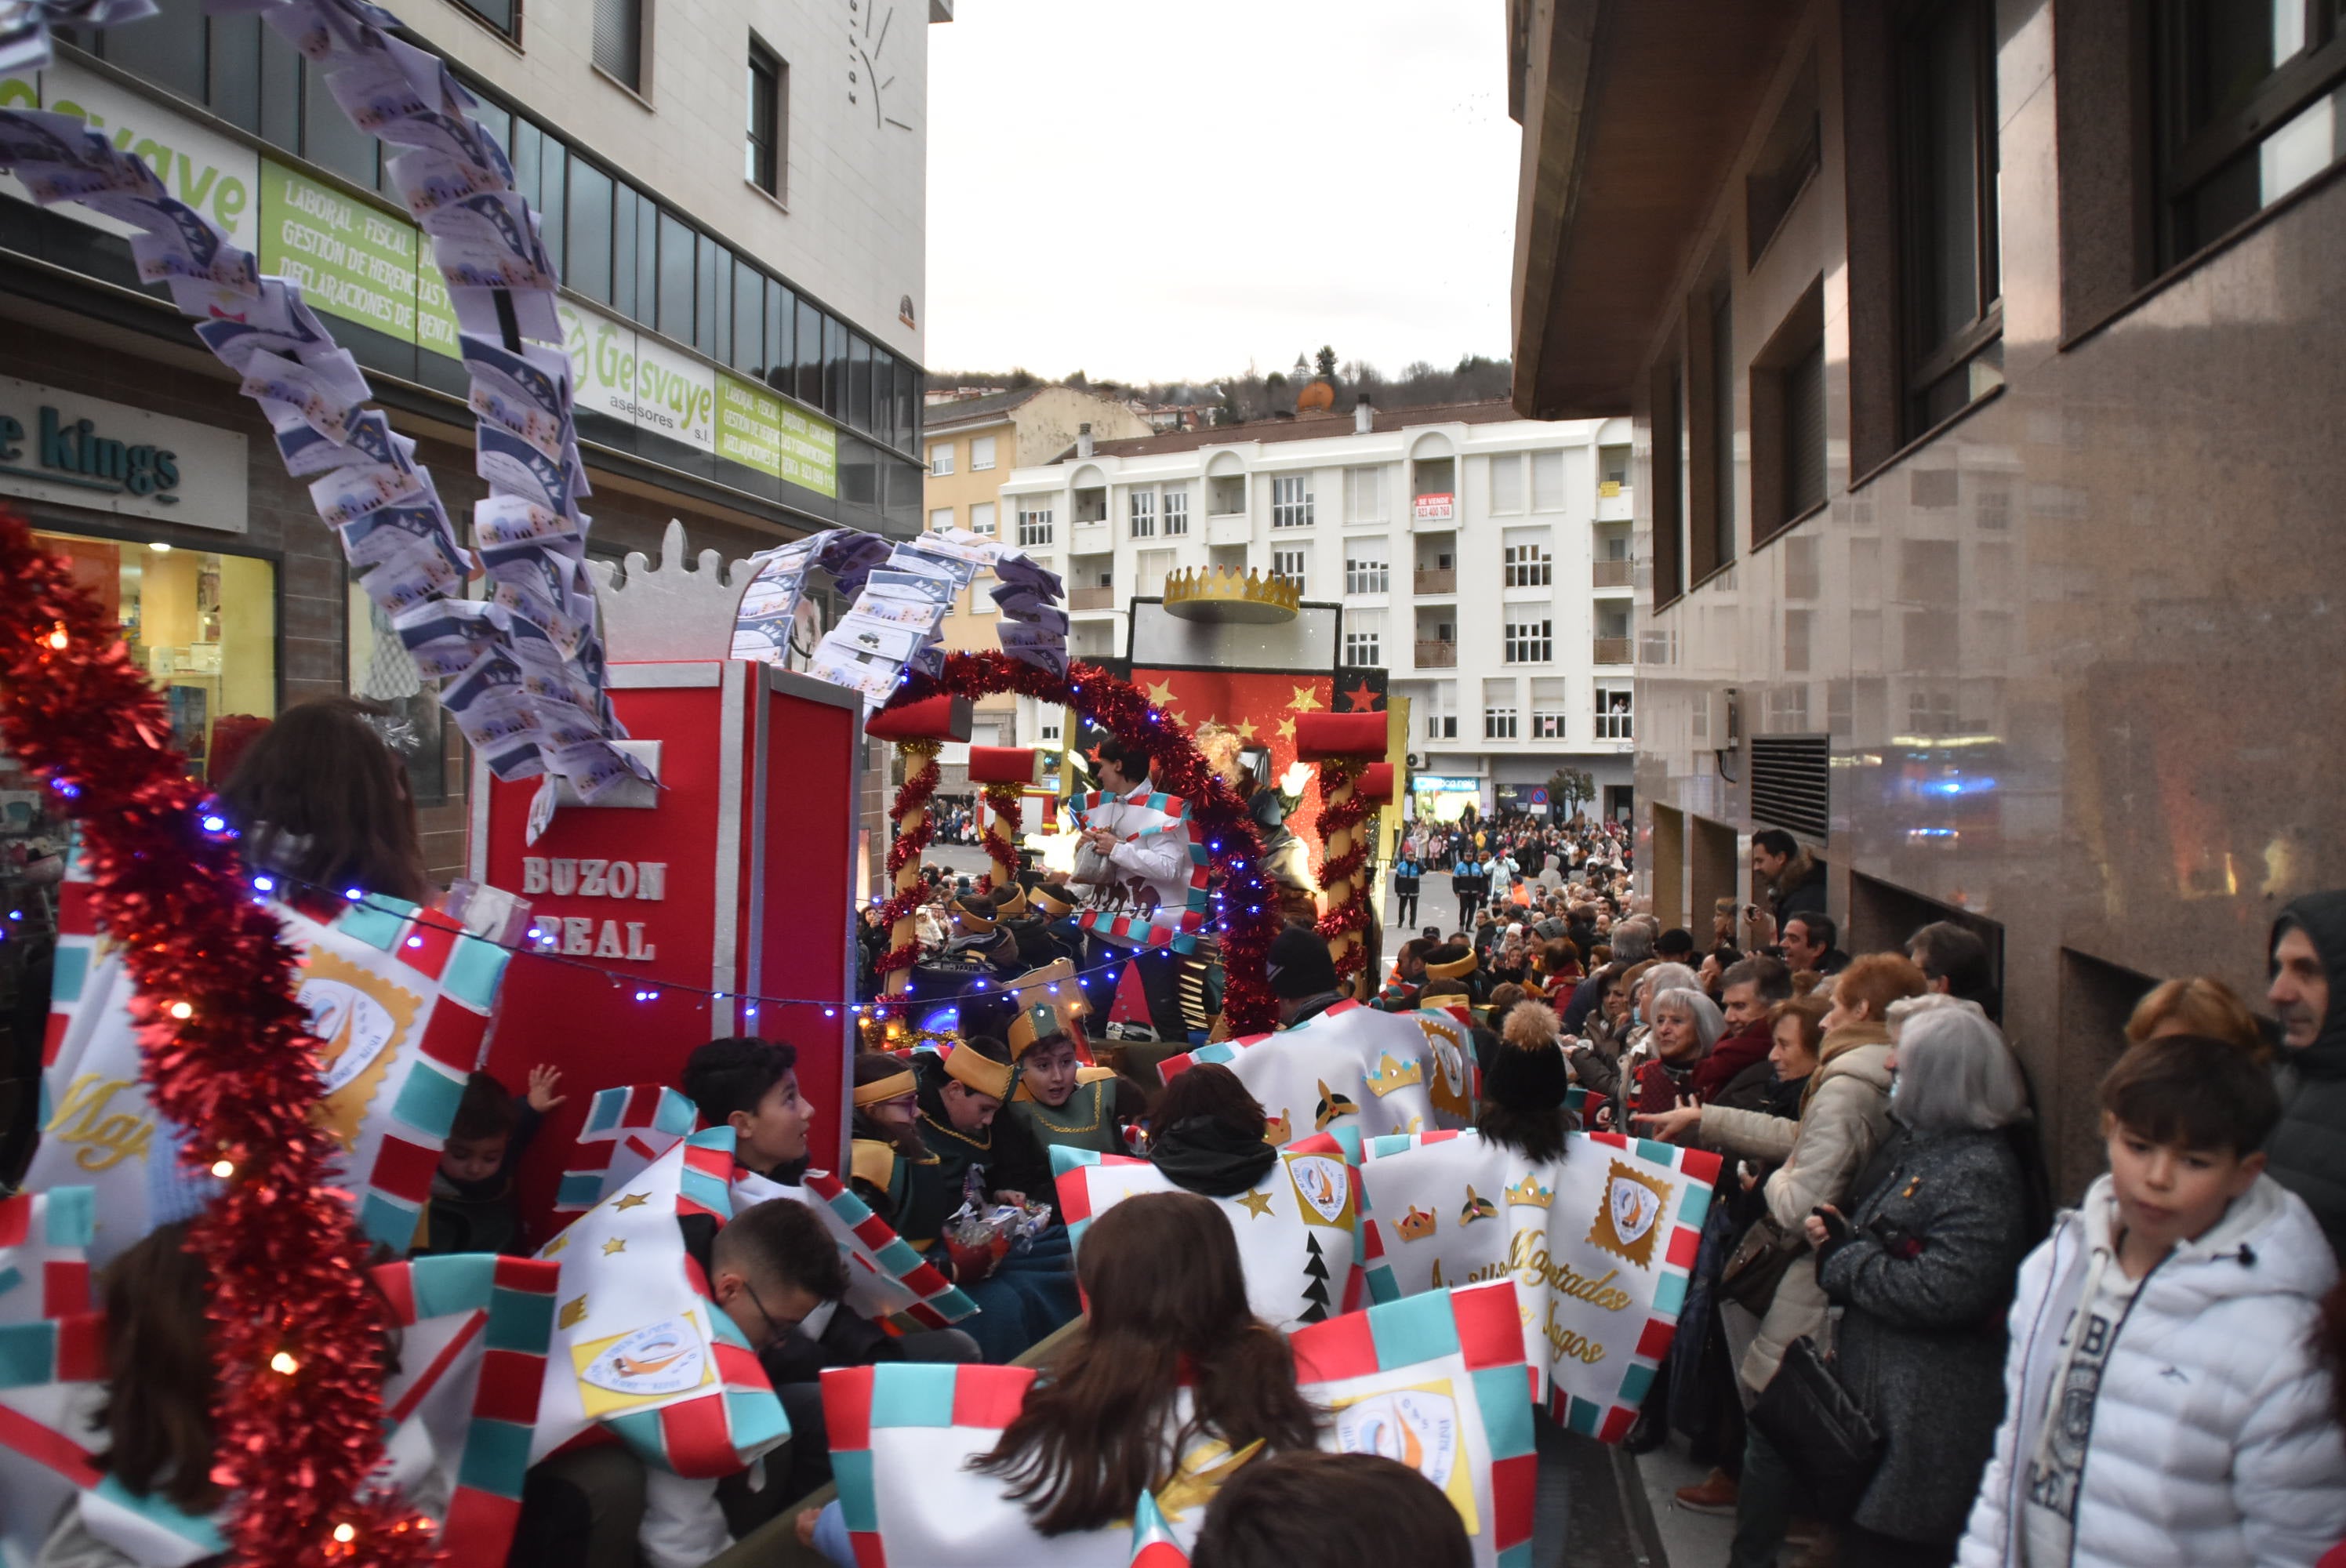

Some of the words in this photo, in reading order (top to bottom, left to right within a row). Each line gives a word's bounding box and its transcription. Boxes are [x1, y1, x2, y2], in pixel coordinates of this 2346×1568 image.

[285, 180, 353, 231] LABORAL
[364, 216, 409, 257] FISCAL
[347, 245, 368, 276] DE
[368, 254, 441, 307] HERENCIAS
[394, 303, 414, 329] DE
[418, 310, 454, 345] RENTA
[595, 321, 713, 430] Gesvaye
[610, 395, 674, 429] asesores
[39, 405, 181, 496] kings
[1428, 496, 1449, 506] VENDE
[522, 857, 668, 901] BUZON
[533, 915, 656, 961] REAL
